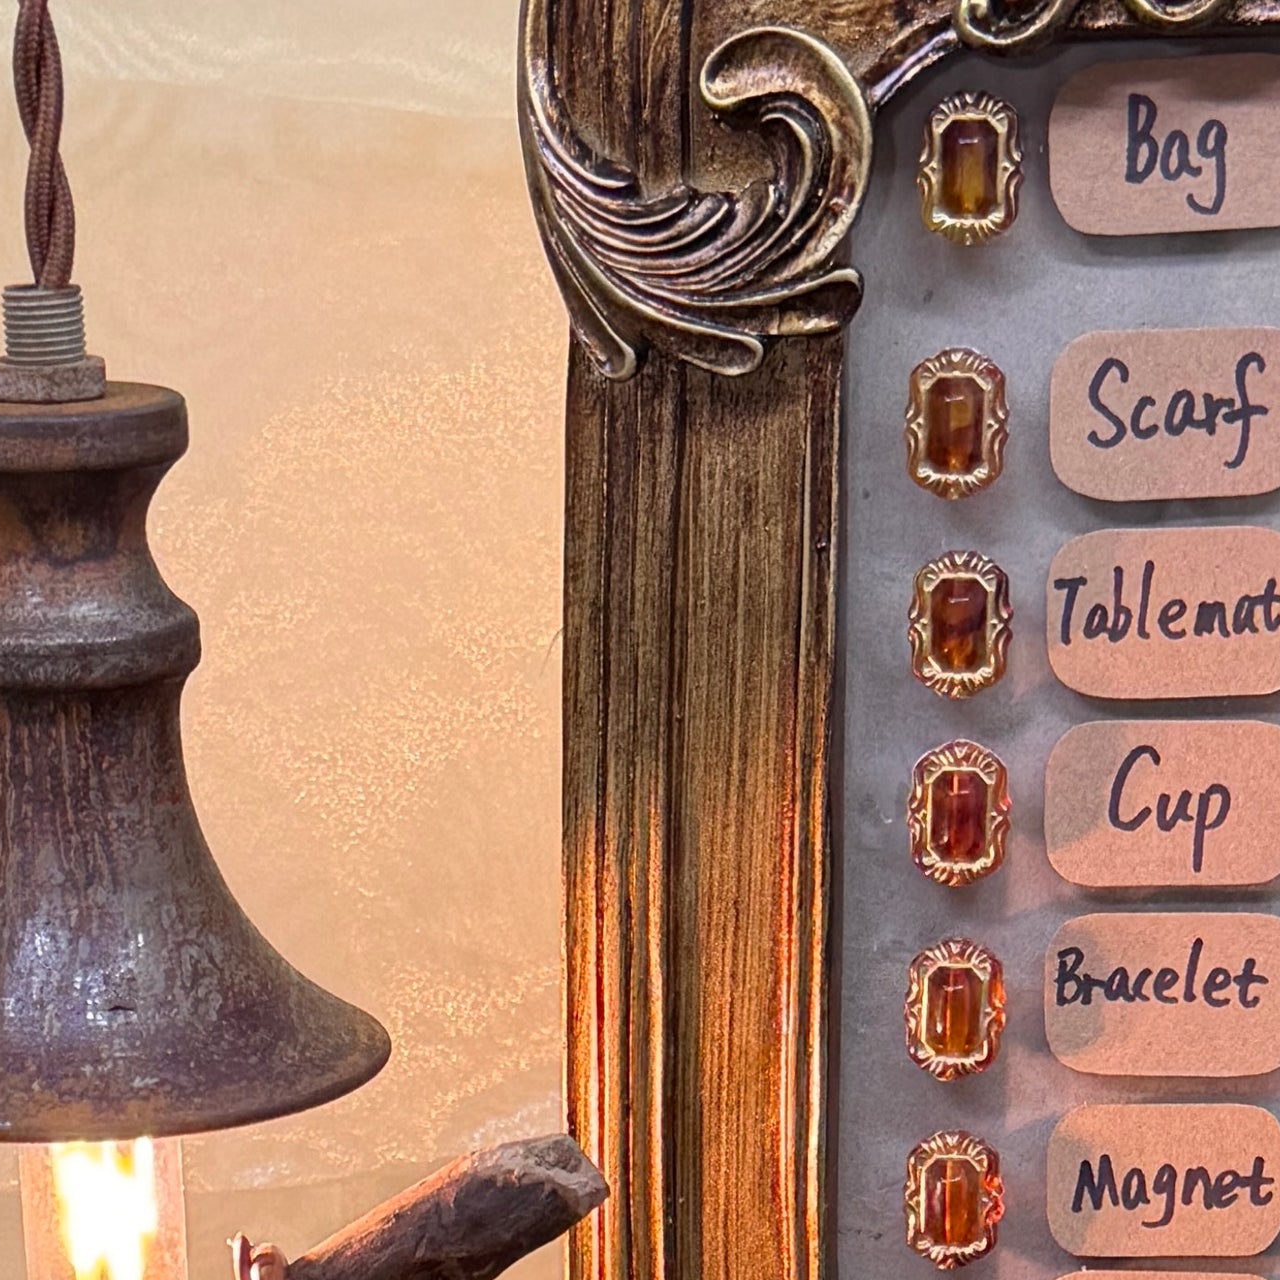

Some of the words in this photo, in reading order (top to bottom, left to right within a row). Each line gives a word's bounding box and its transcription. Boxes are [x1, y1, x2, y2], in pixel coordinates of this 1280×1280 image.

[1123, 93, 1230, 214] Bag
[1088, 352, 1268, 468] Scarf
[1109, 745, 1230, 872] Cup
[1054, 938, 1268, 1007] Bracelet
[1071, 1154, 1274, 1227] Magnet
